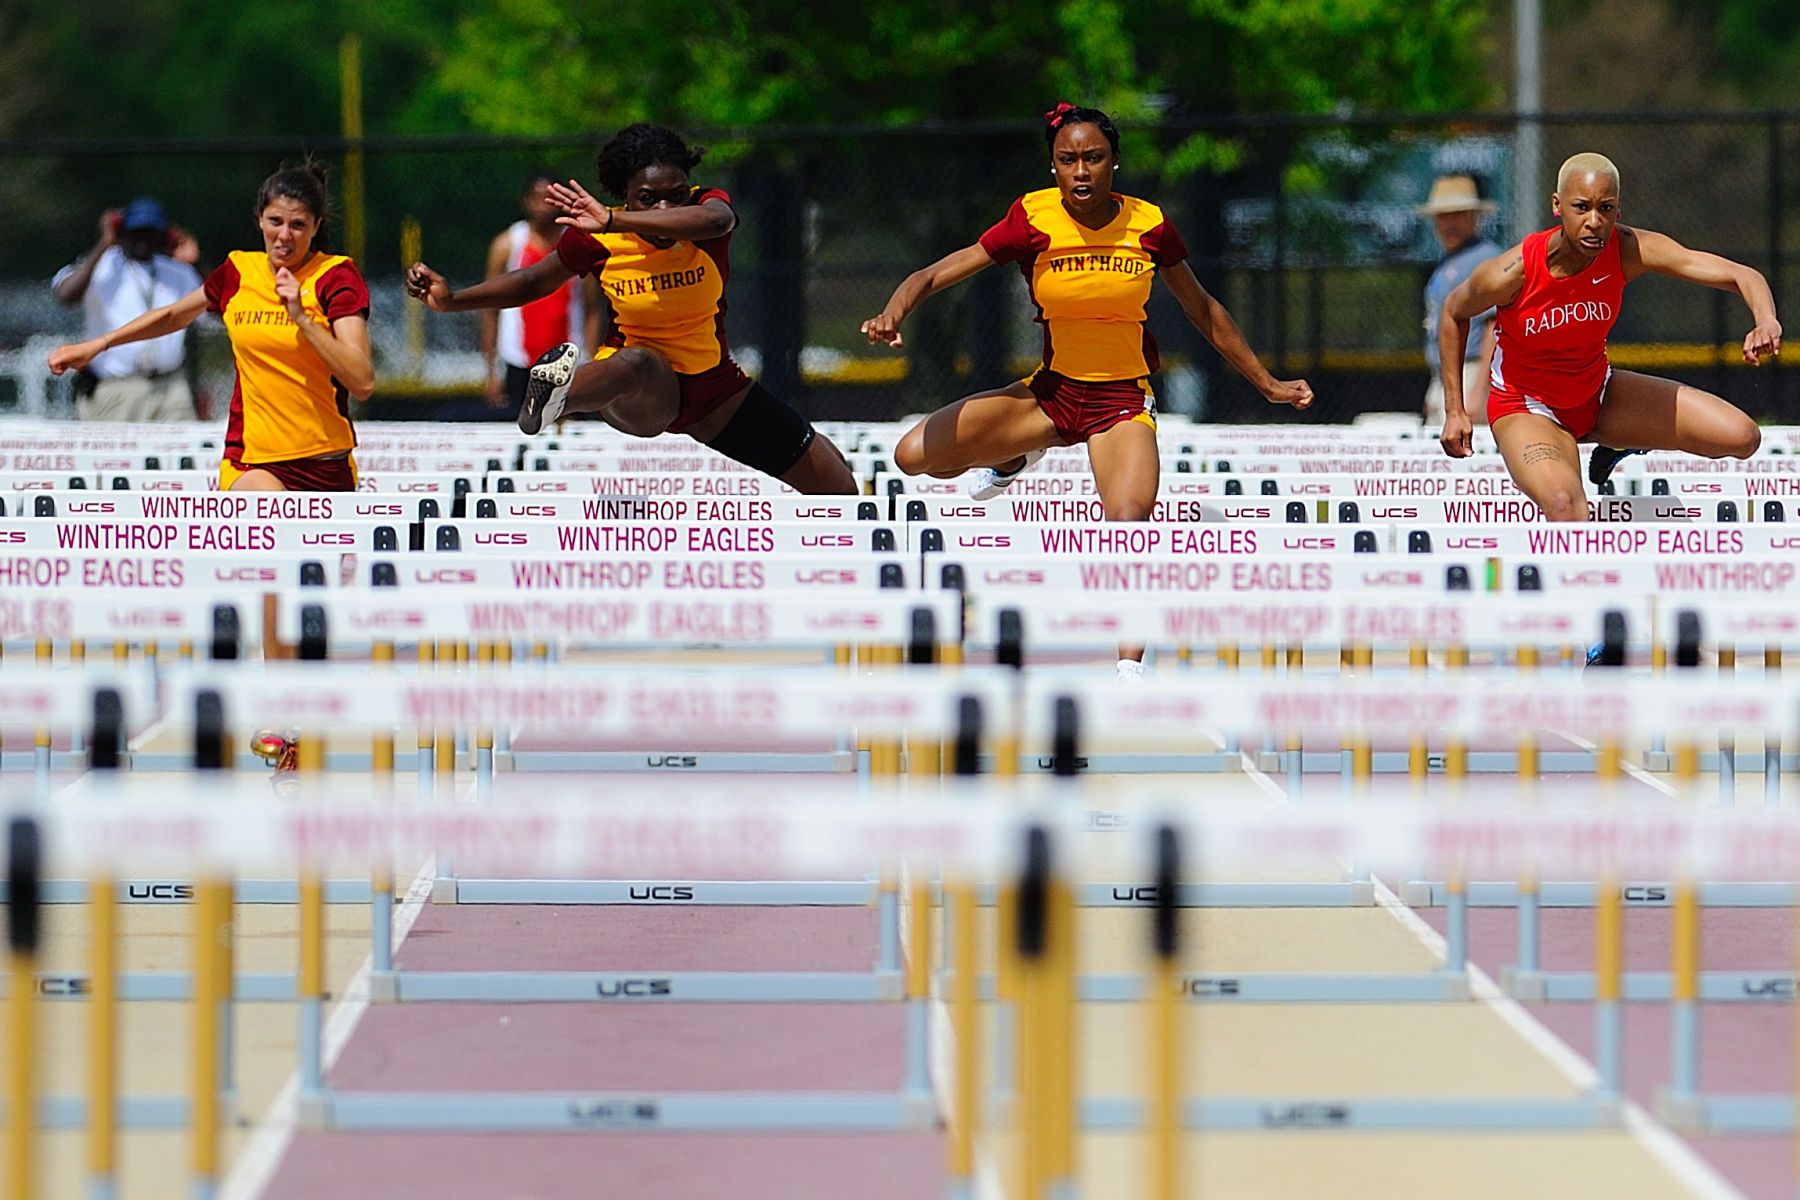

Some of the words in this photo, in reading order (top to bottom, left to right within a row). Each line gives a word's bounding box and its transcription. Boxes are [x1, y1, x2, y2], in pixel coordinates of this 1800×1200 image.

[1049, 255, 1144, 275] WINTHROP
[610, 265, 705, 297] WINTHROP
[233, 310, 296, 326] WINTH
[1524, 301, 1611, 337] RADFORD
[12, 482, 54, 491] UCS
[142, 482, 183, 491] UCS
[398, 483, 439, 492] UCS
[526, 483, 567, 492] UCS
[591, 478, 684, 497] WINTHROP
[693, 478, 760, 496] EAGLES
[916, 484, 958, 494] UCS
[1169, 485, 1210, 494] UCS
[1291, 484, 1331, 494] UCS
[1355, 479, 1446, 496] WINTHROP
[1681, 484, 1722, 493] UCS
[69, 503, 115, 512] UCS
[142, 497, 247, 518] WINTHROP
[257, 498, 332, 519] EAGLES
[357, 505, 402, 515] UCS
[510, 506, 556, 516] UCS
[582, 498, 689, 520] WINTHROP
[697, 501, 772, 520] EAGLES
[796, 508, 841, 517] UCS
[941, 507, 986, 517] UCS
[1011, 500, 1103, 522] WINTHRO
[1152, 500, 1202, 522] GLES
[1224, 508, 1270, 518] UCS
[1373, 508, 1417, 517] UCS
[1443, 500, 1543, 523] WINTHRO
[1587, 500, 1633, 523] GLES
[1654, 506, 1703, 519] UCS
[57, 524, 177, 549] WINTHROP
[189, 525, 275, 550] EAGLES
[303, 534, 354, 544] UCS
[475, 533, 527, 544] UCS
[558, 527, 677, 551] WINTHROP
[688, 527, 774, 552] EAGLES
[802, 536, 853, 546] UCS
[959, 536, 1011, 547] UCS
[1041, 529, 1160, 553] WINTHROP
[1172, 530, 1256, 554] EAGLES
[1284, 538, 1335, 549] UCS
[1447, 538, 1498, 548] UCS
[1528, 530, 1647, 554] WINTHROP
[1658, 530, 1743, 553] EAGLES
[1769, 535, 1800, 549] UC
[83, 558, 184, 587] EAGLES
[215, 568, 277, 582] UCS
[416, 570, 477, 583] UCS
[512, 562, 651, 588] WINTHROP
[664, 561, 764, 589] EAGLES
[795, 570, 857, 584] UCS
[984, 571, 1044, 584] UCS
[1080, 563, 1219, 591] WINTHROP
[1232, 563, 1332, 591] EAGLES
[1656, 563, 1794, 591] WINTHROP
[647, 755, 697, 768] UCS
[1038, 757, 1089, 769] US
[129, 884, 194, 899] UCS
[630, 886, 693, 901] UCS
[1113, 887, 1157, 901] UC
[1624, 887, 1666, 901] CS
[34, 978, 92, 995] CS
[597, 979, 671, 997] UCS
[1182, 979, 1239, 996] CS
[1744, 978, 1792, 995] UC
